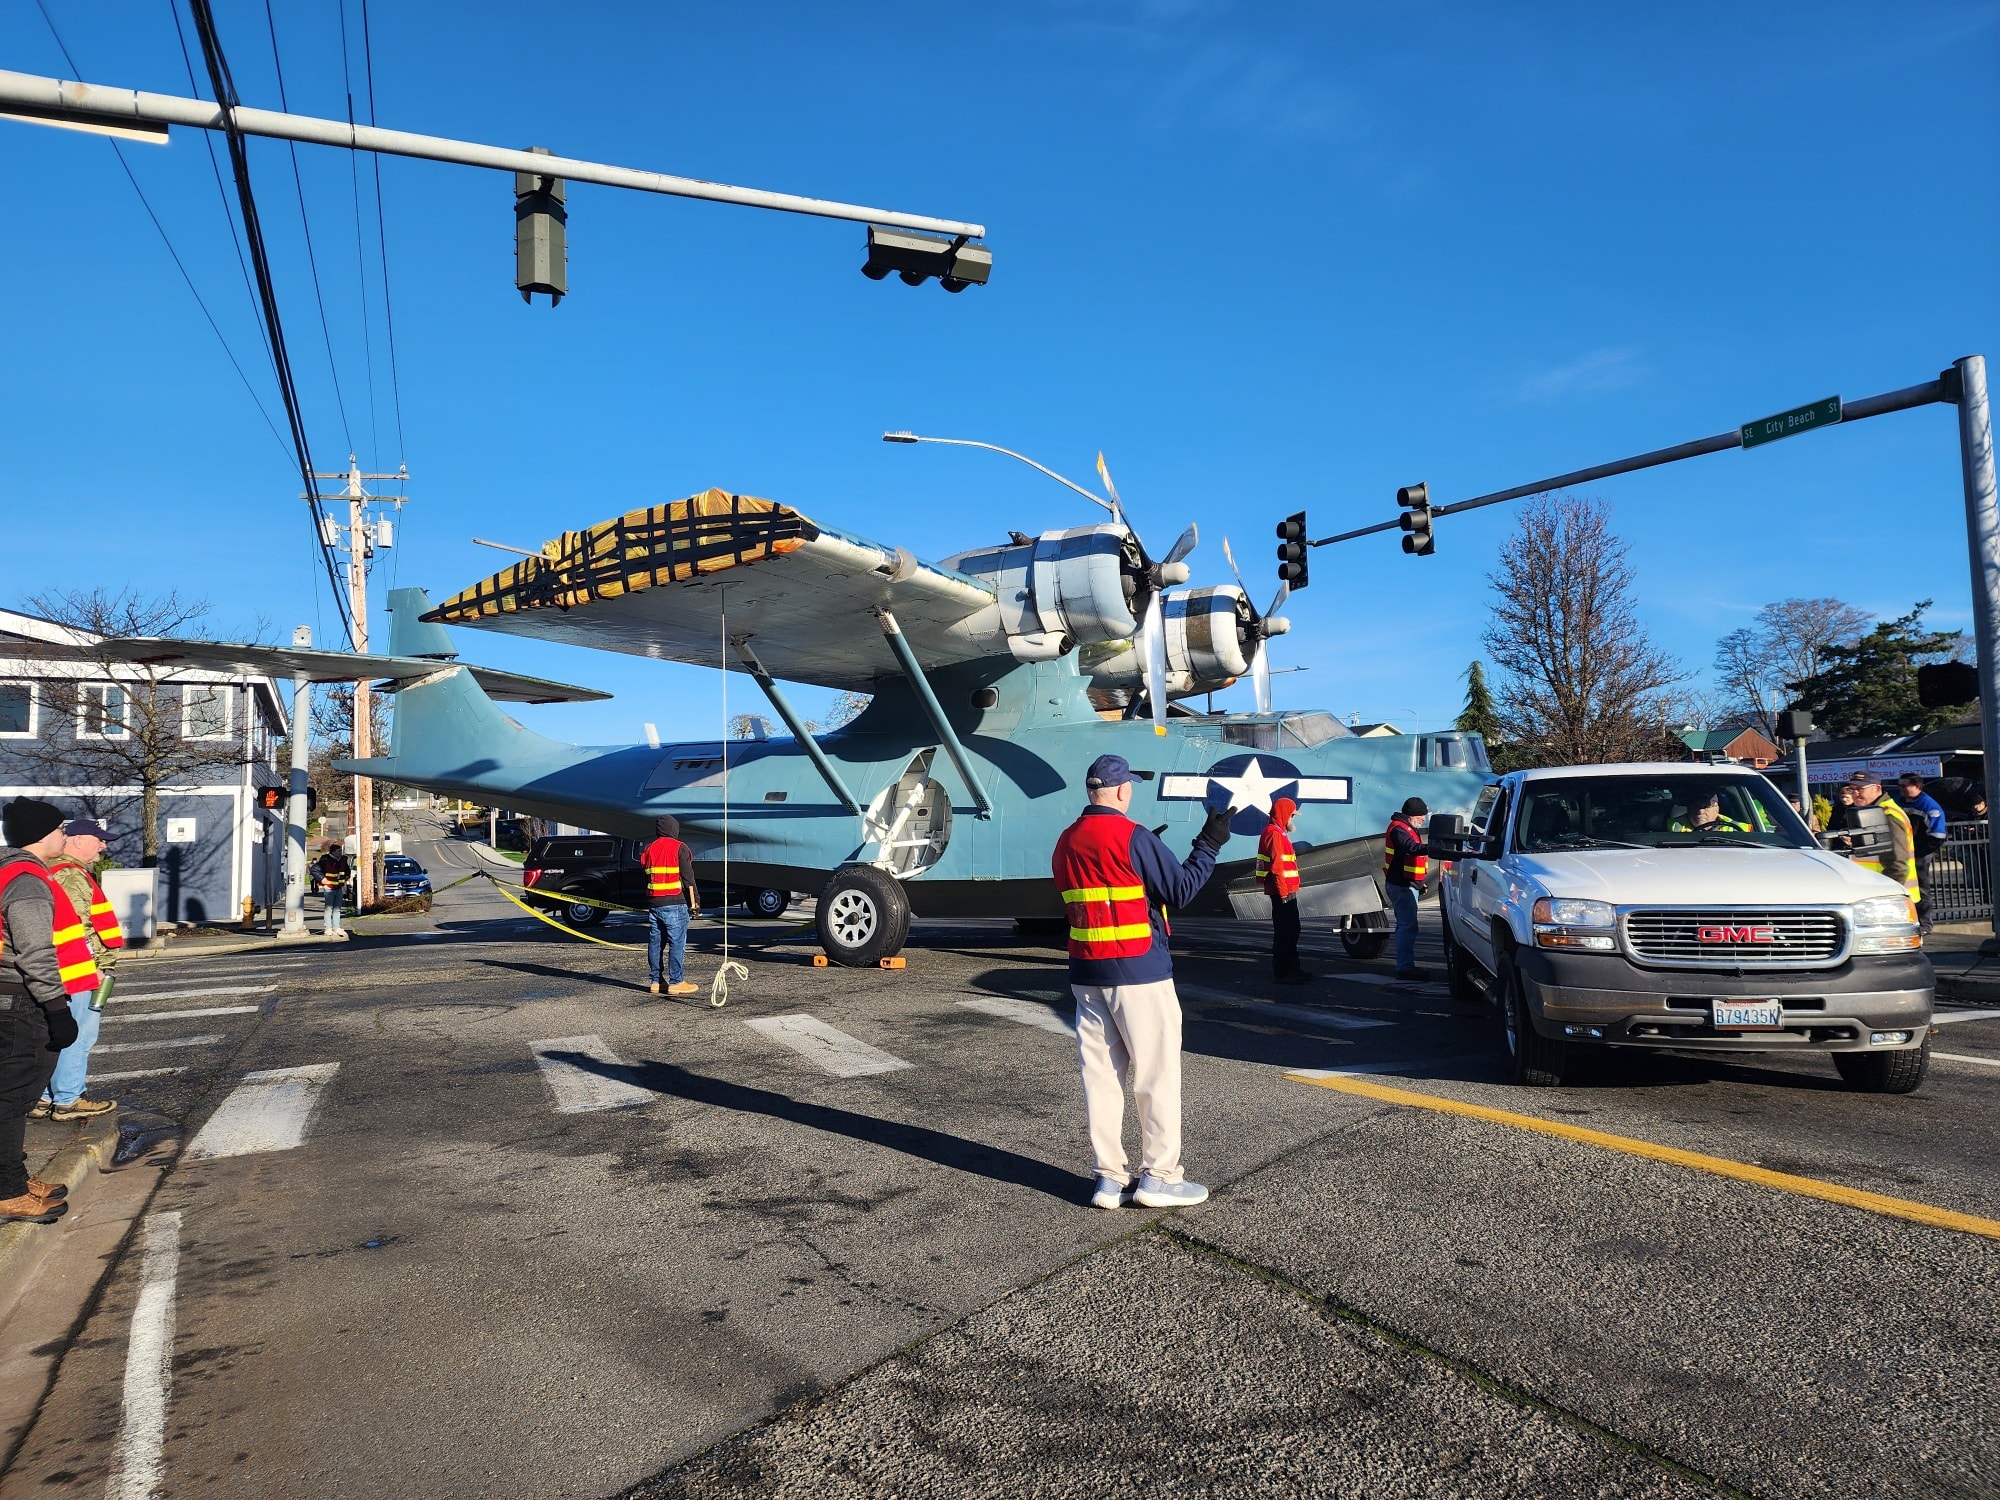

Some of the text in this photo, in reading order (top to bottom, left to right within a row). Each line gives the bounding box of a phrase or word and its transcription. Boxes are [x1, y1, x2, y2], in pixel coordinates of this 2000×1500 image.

[1766, 420, 1784, 433] City
[1788, 410, 1815, 427] Beach
[1828, 402, 1837, 413] St
[1869, 760, 1905, 768] MONTHLY
[1916, 758, 1938, 766] LONG
[1698, 926, 1774, 942] GMC
[1716, 1009, 1778, 1024] B79435K
